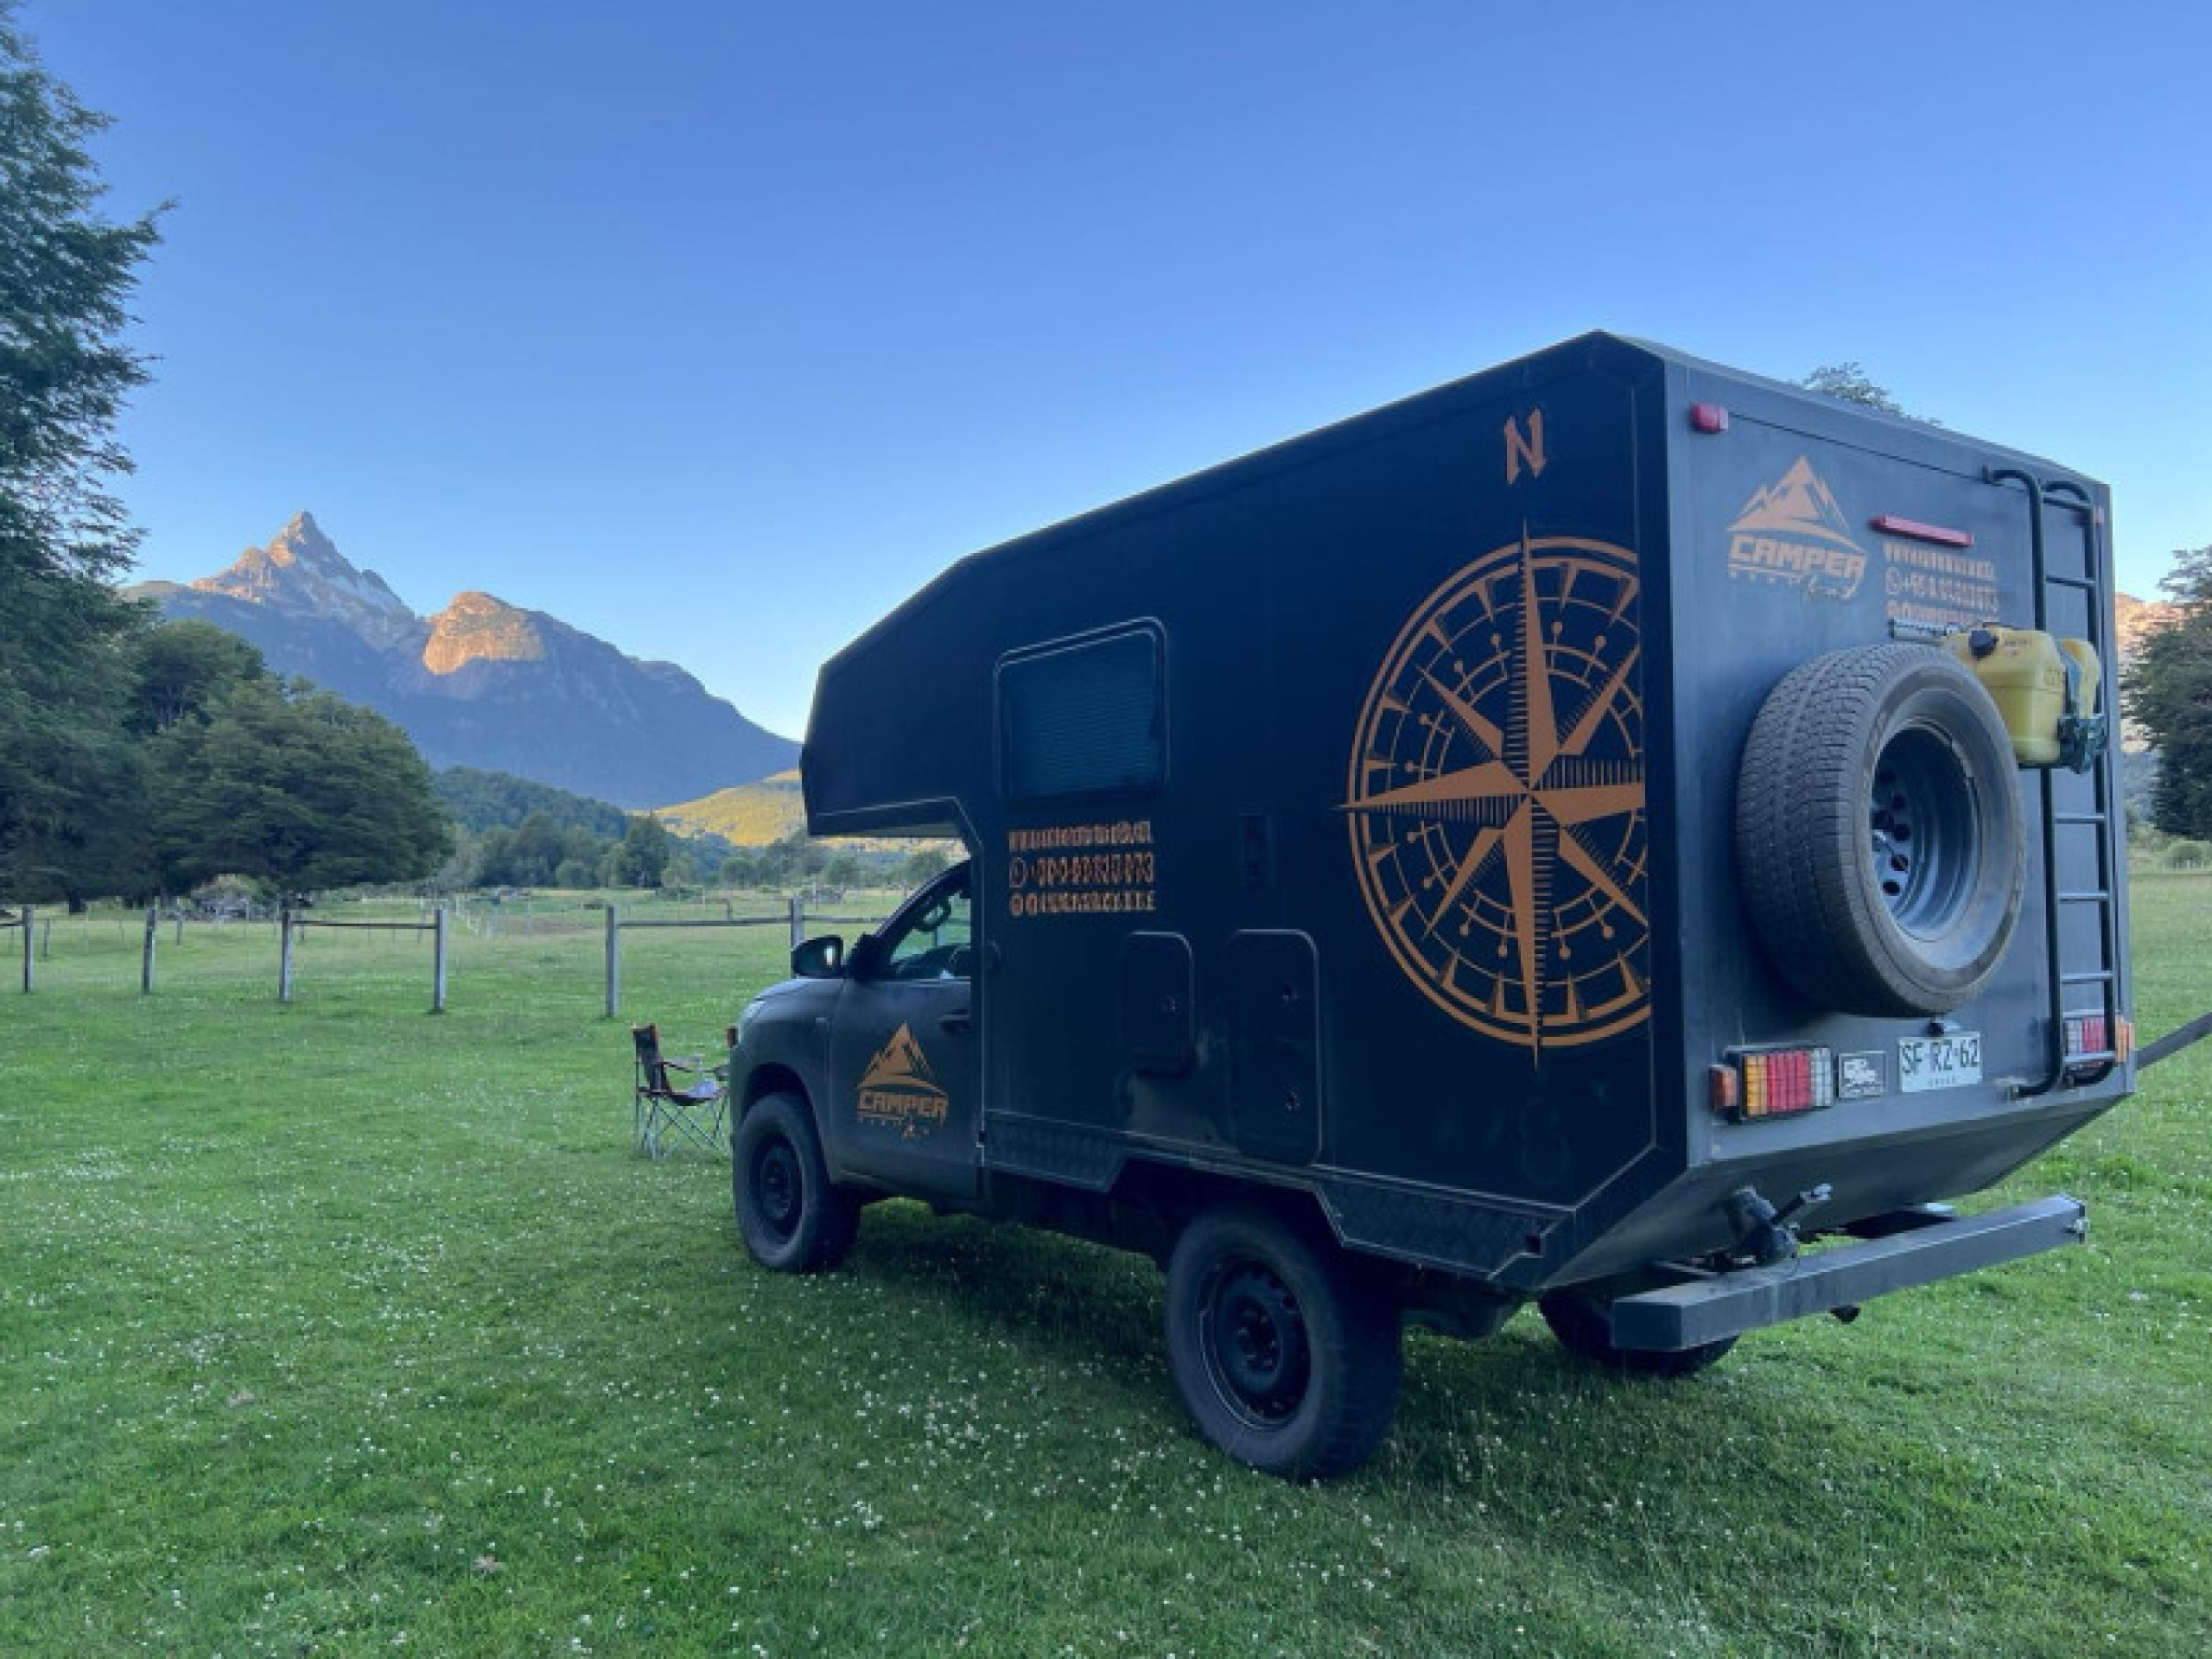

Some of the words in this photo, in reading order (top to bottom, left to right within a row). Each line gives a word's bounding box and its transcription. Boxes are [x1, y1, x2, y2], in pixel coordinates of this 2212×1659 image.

[1503, 408, 1547, 484] N
[1730, 536, 1866, 581] CAMPER
[857, 1092, 949, 1123] CAMPER
